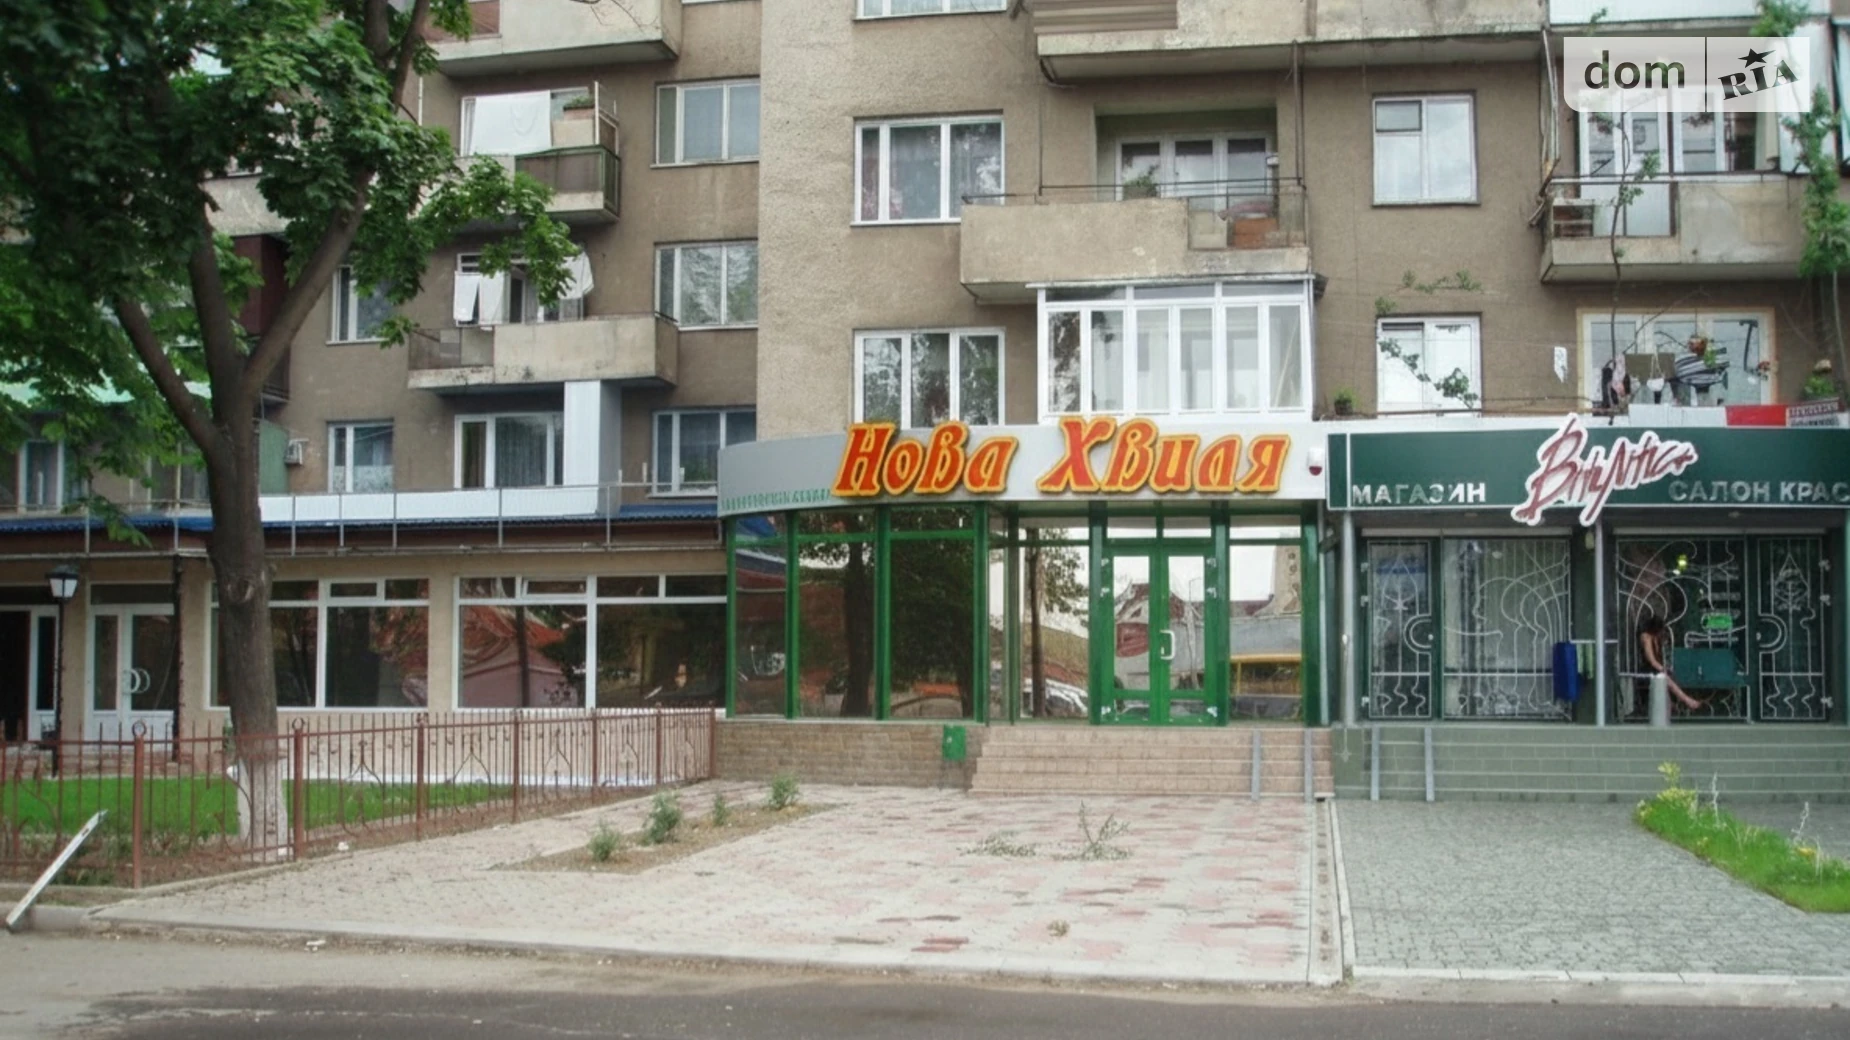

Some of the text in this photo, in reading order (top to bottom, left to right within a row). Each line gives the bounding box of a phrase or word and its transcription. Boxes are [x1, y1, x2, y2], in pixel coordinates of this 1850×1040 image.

[1352, 482, 1486, 505] МАГАЗИН
[1668, 480, 1850, 502] САЛОН КРАС
